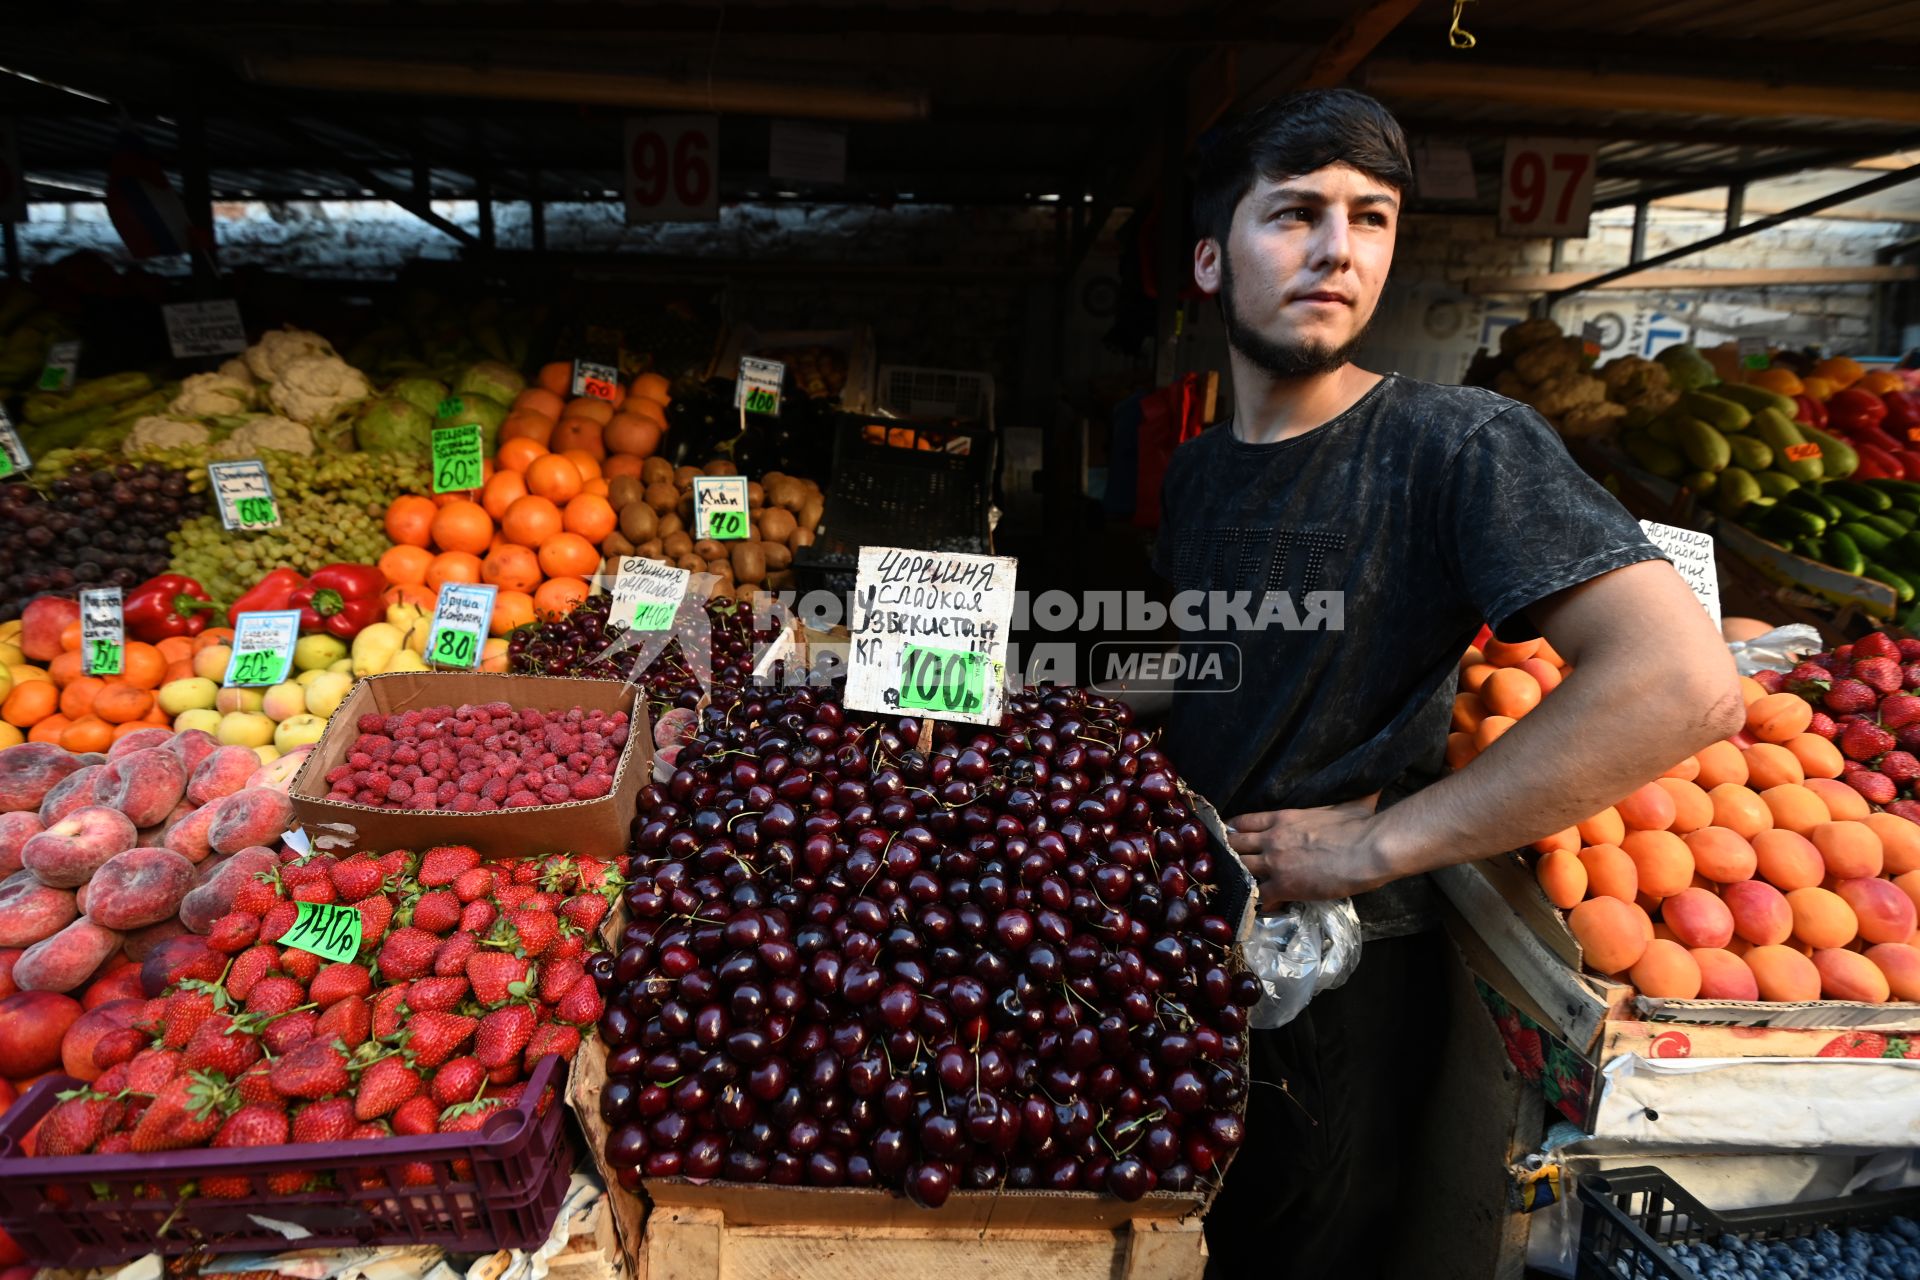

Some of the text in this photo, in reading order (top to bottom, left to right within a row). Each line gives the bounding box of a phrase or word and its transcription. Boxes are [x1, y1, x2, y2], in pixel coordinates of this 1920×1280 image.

[633, 131, 709, 206] 96
[1509, 151, 1590, 225] 97
[439, 630, 470, 660] 80
